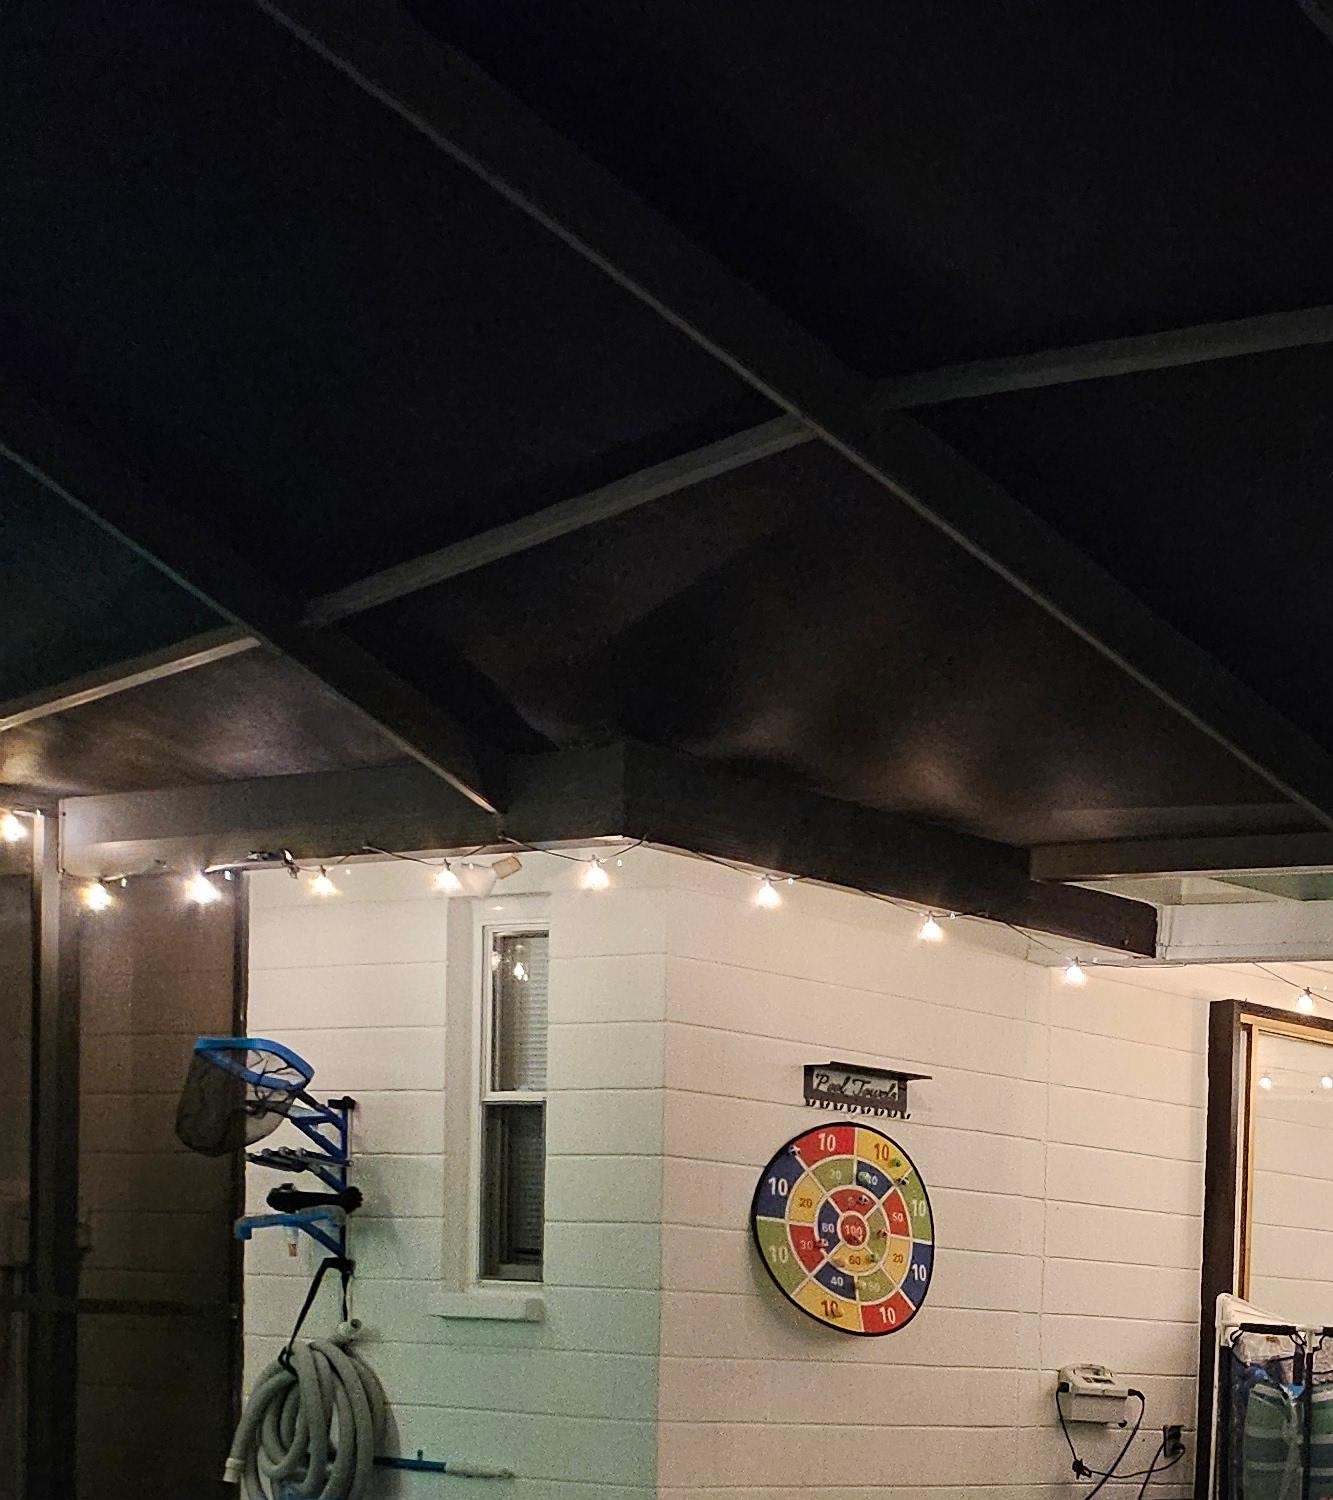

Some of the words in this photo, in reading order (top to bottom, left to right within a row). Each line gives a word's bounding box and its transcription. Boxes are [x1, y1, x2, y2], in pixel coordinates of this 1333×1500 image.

[818, 1132, 836, 1152] 10
[874, 1142, 889, 1161] 10
[768, 1177, 788, 1196] 10
[799, 1197, 813, 1209] 20
[912, 1199, 926, 1217] 10
[892, 1211, 903, 1223] 50
[799, 1239, 813, 1250] 30
[769, 1245, 789, 1263] 10
[830, 1276, 844, 1286] 40
[912, 1263, 927, 1281] 10
[821, 1300, 840, 1319] 10
[879, 1306, 896, 1325] 10
